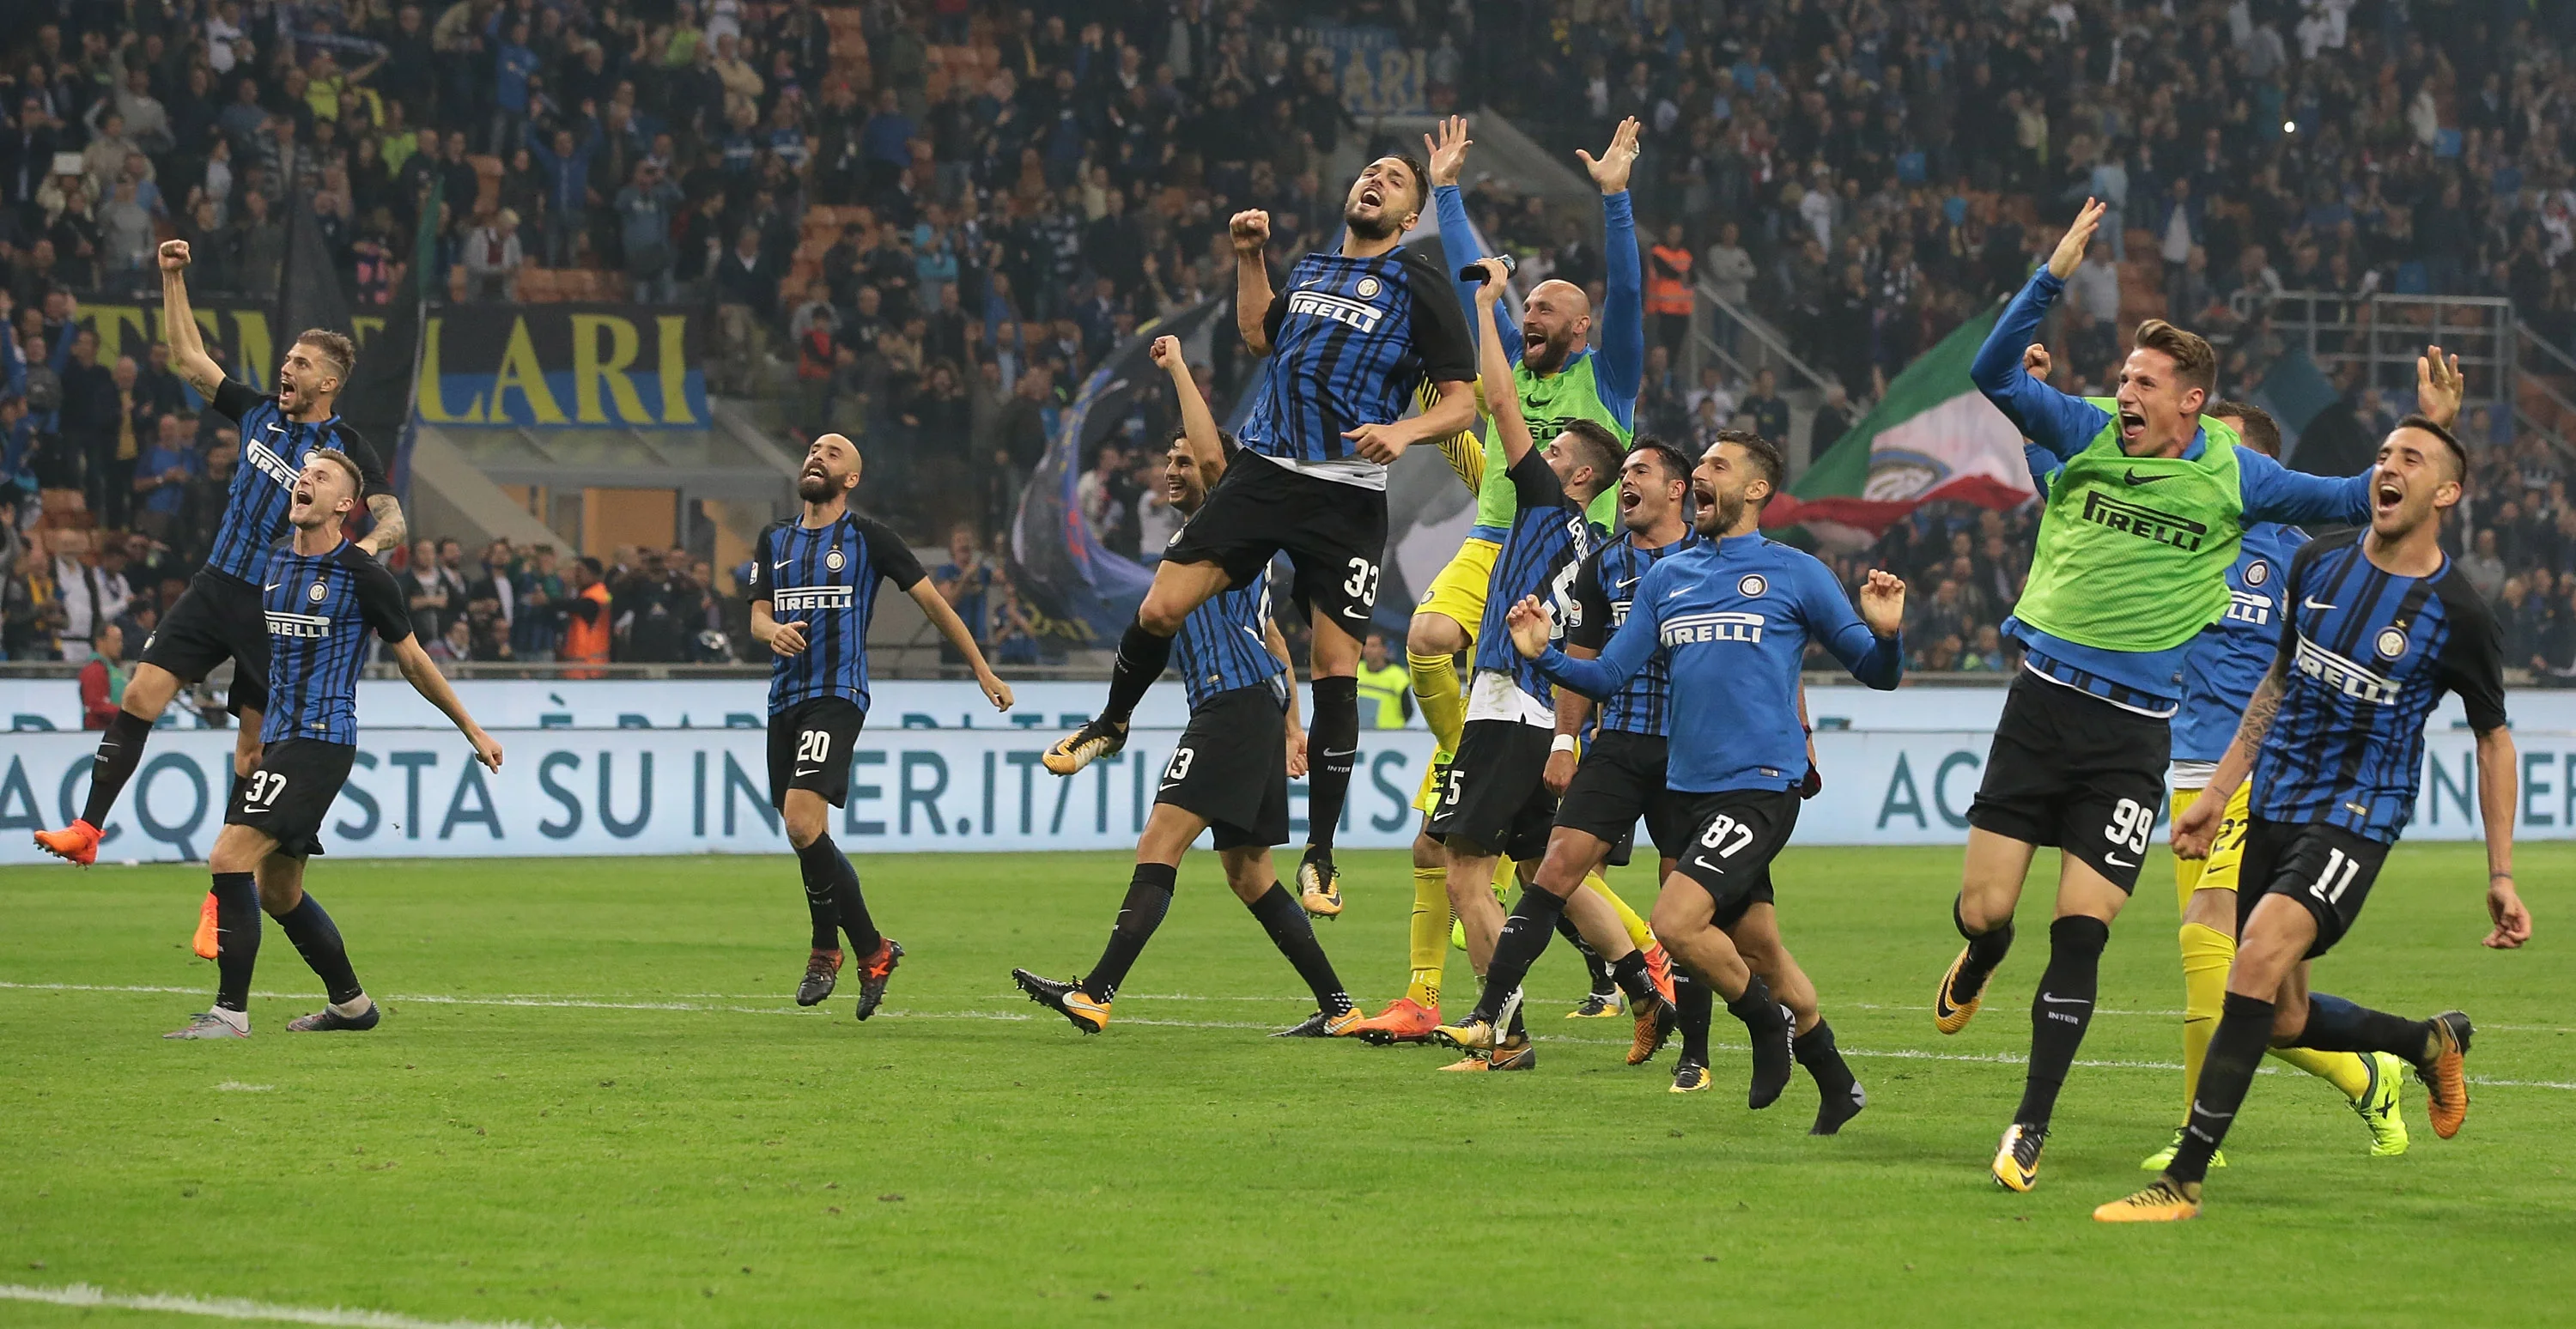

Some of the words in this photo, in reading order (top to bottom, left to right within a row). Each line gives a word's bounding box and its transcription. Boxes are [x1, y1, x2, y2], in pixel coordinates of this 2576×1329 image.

[1287, 290, 1382, 334] PIRELLI
[246, 438, 301, 493] PIREL
[2082, 490, 2207, 552] PIRELLI
[775, 586, 854, 612] PIRELLI
[1344, 556, 1379, 607] 33
[1661, 612, 1765, 646] PIRELLI
[796, 729, 830, 763] 20
[1163, 747, 1194, 780] 13
[245, 769, 288, 807] 37
[1326, 765, 1352, 774] INTER
[1445, 769, 1465, 805] 5
[0, 751, 505, 860] ACQSTA
[538, 749, 653, 840] SU
[693, 749, 1409, 836] INER.IT/TIS
[1700, 814, 1754, 859] 87
[2104, 798, 2154, 855] 99
[2213, 818, 2250, 853] 27
[2316, 847, 2360, 905] 11
[2048, 1010, 2079, 1025] INTER
